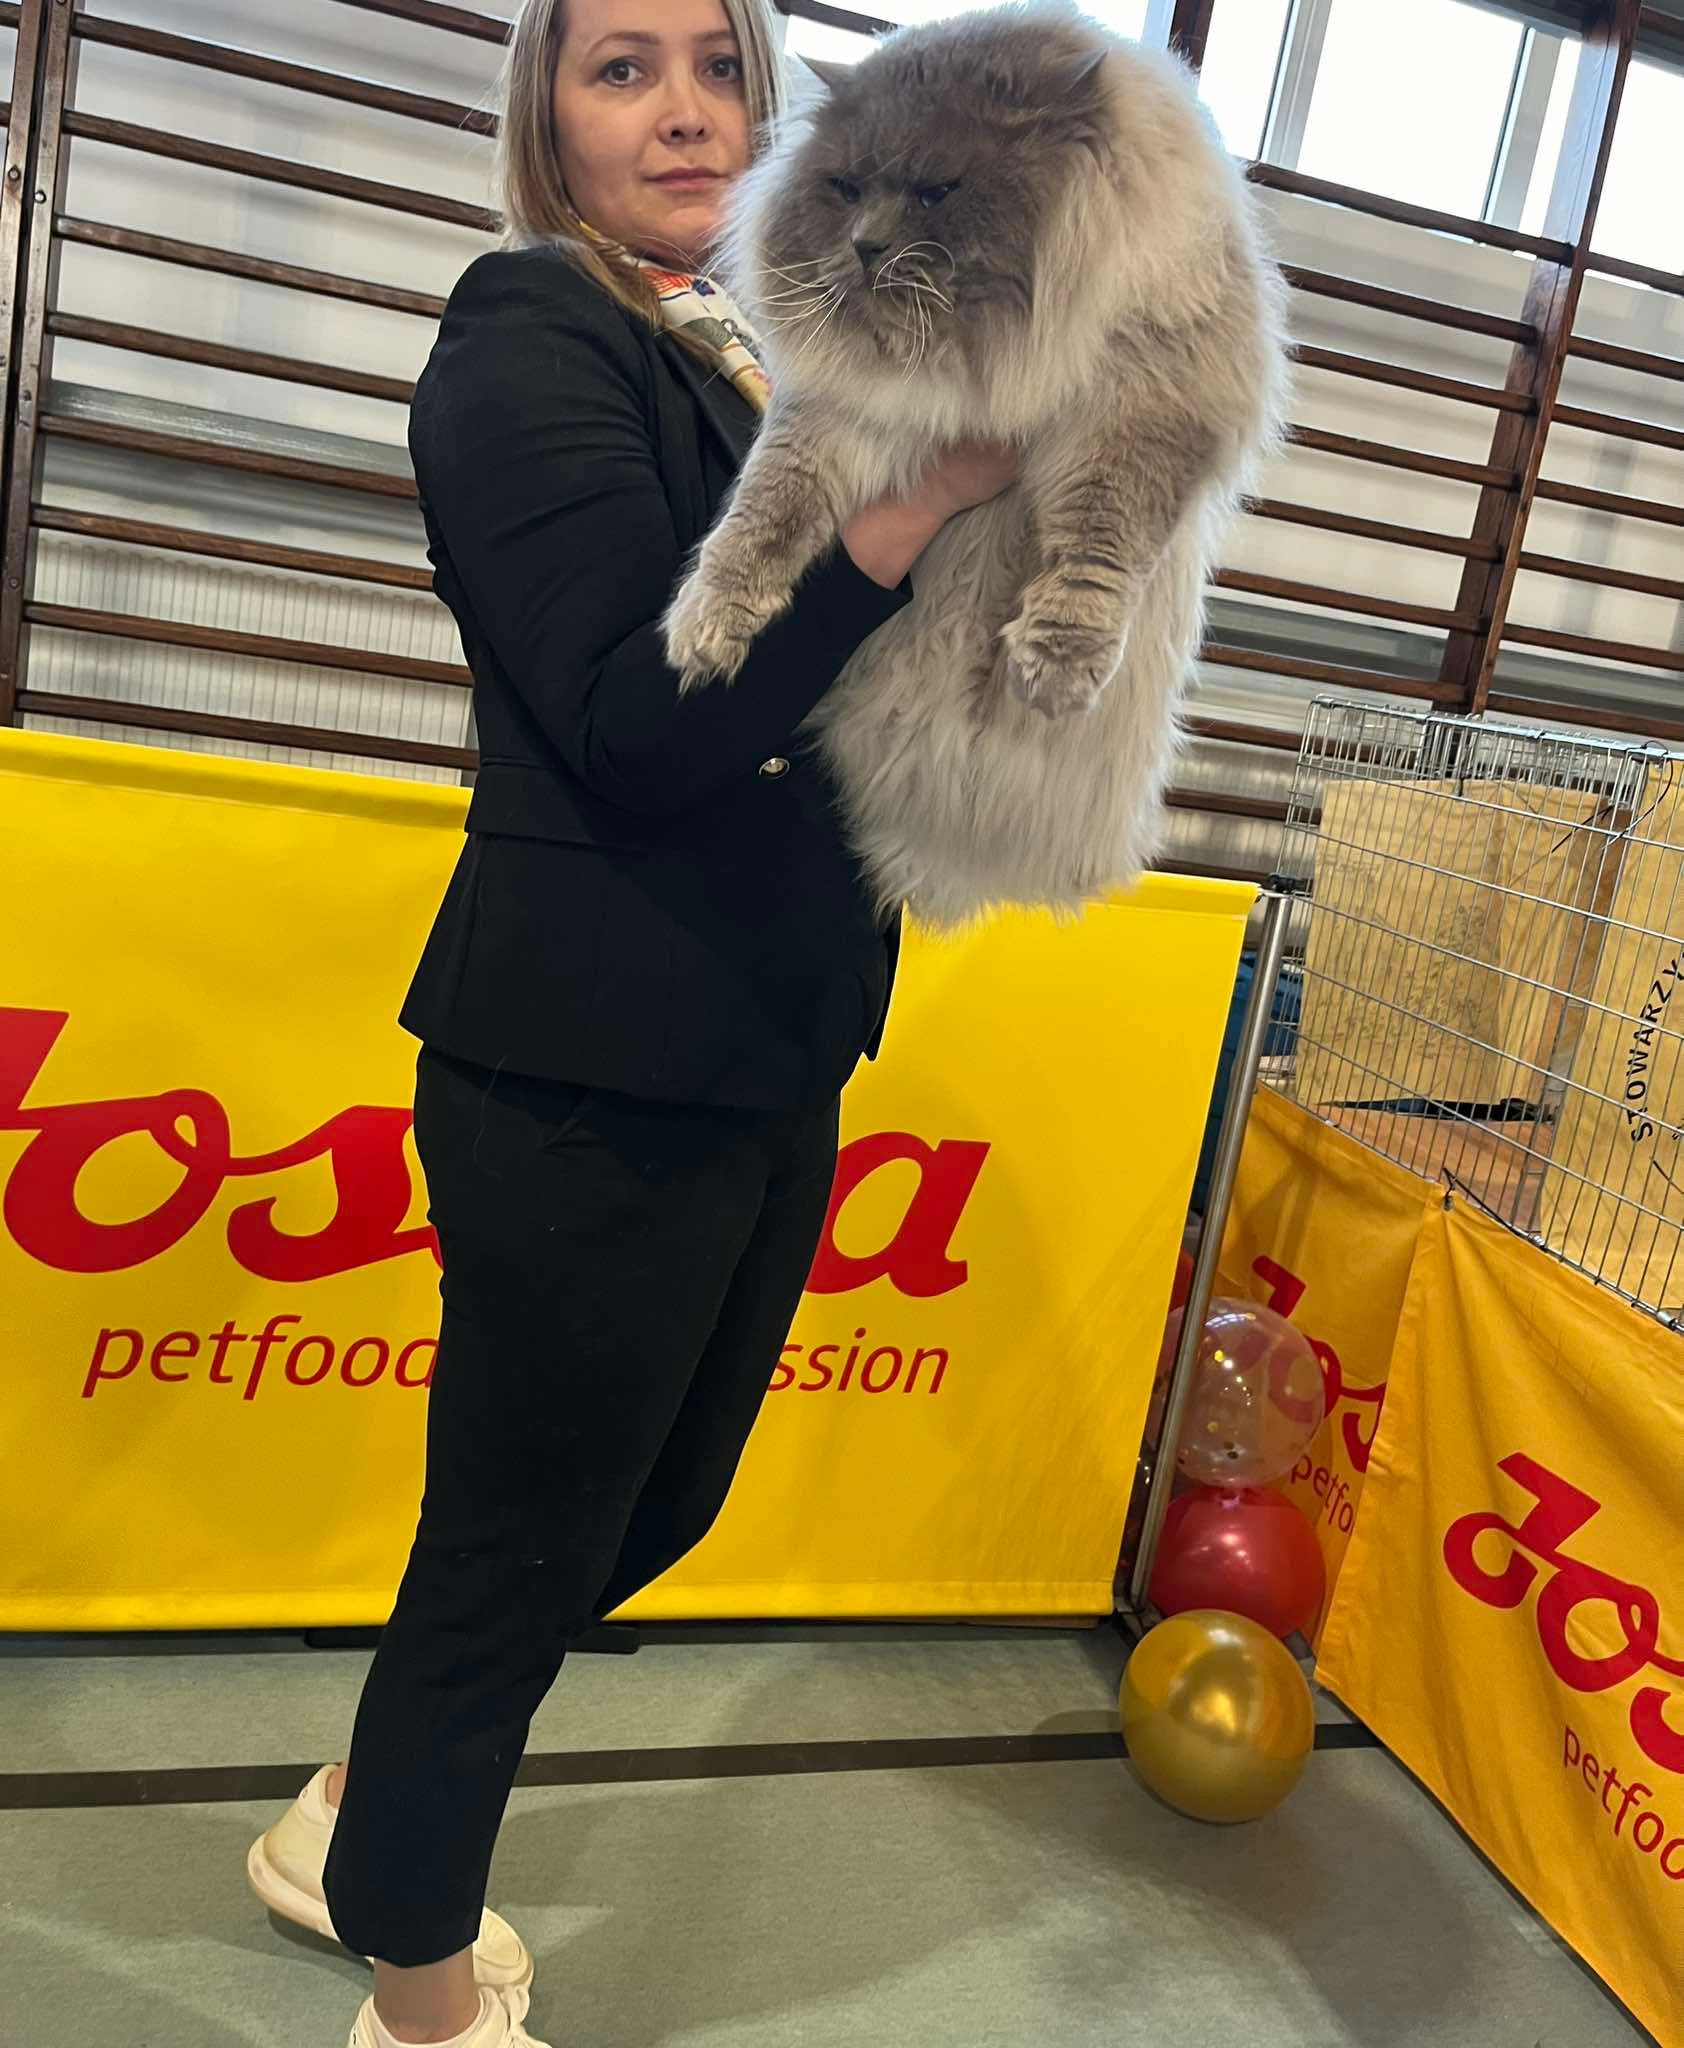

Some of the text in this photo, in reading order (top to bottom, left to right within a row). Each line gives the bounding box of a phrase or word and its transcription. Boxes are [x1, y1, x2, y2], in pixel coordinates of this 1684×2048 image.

[1627, 953, 1684, 1143] STOWARZY
[766, 1327, 950, 1394] ssion
[1564, 1724, 1684, 1881] petfoo
